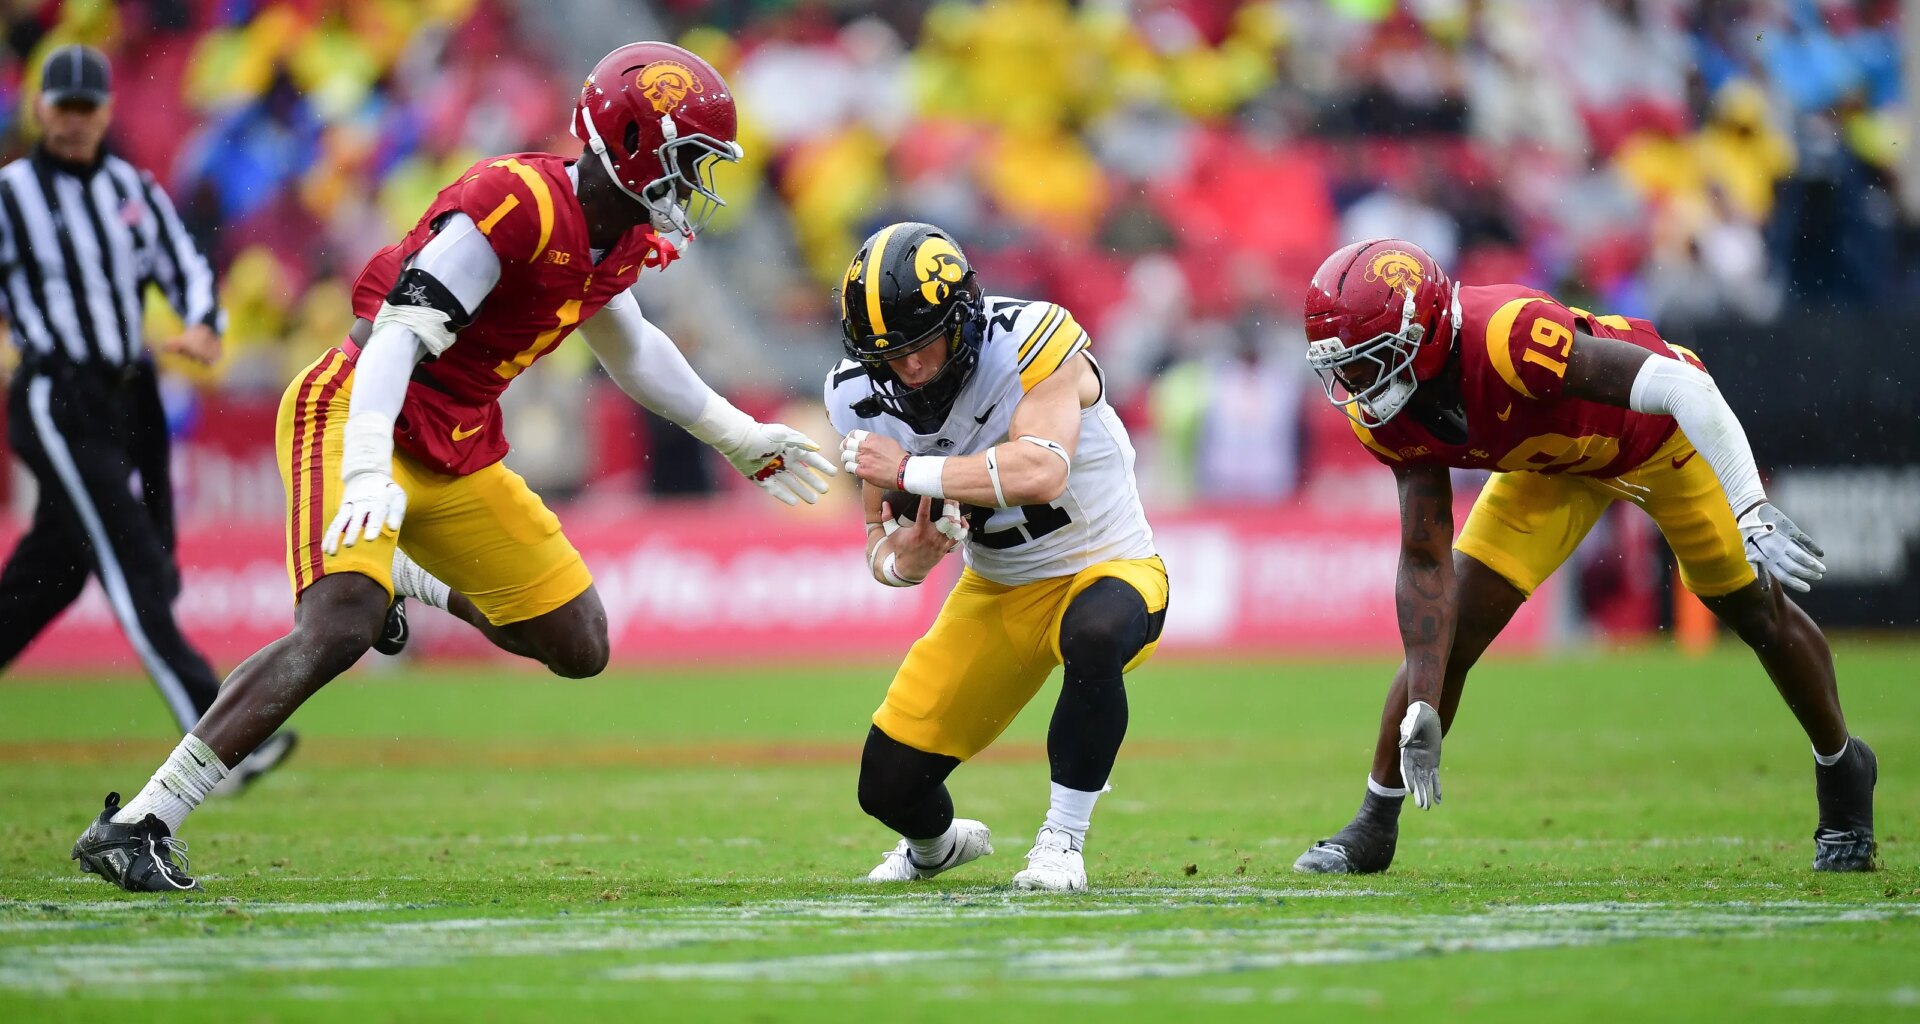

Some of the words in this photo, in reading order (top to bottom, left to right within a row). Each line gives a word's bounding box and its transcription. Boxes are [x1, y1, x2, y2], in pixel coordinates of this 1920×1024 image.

[477, 193, 520, 236] 1
[493, 299, 583, 380] 1
[1522, 316, 1574, 379] 19
